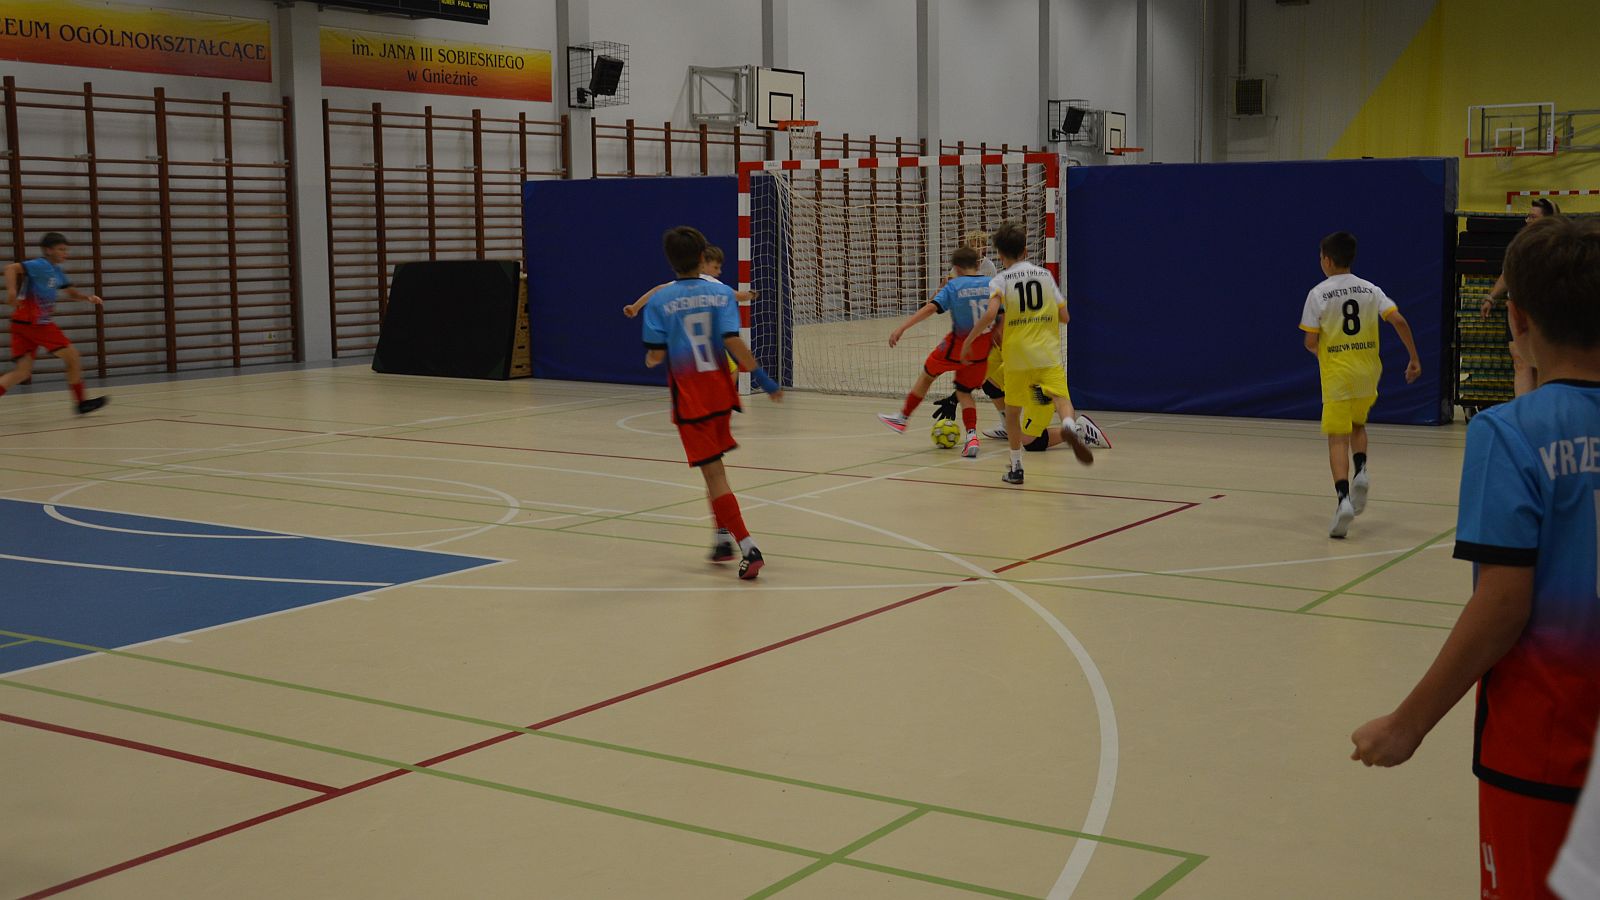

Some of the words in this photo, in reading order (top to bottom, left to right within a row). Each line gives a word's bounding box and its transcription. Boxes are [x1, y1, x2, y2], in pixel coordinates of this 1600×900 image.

[0, 17, 51, 40] EUM
[59, 21, 266, 62] OGÓLNOKSZTAŁCĄCE
[352, 40, 374, 57] im.
[379, 44, 415, 61] JANA
[420, 47, 433, 62] III
[438, 49, 525, 71] SOBIESKIEGO
[407, 70, 417, 81] w
[422, 69, 479, 87] Gnieźnie
[1014, 280, 1043, 313] 10
[1342, 299, 1360, 336] 8
[683, 312, 720, 372] 8
[1025, 418, 1032, 430] 1
